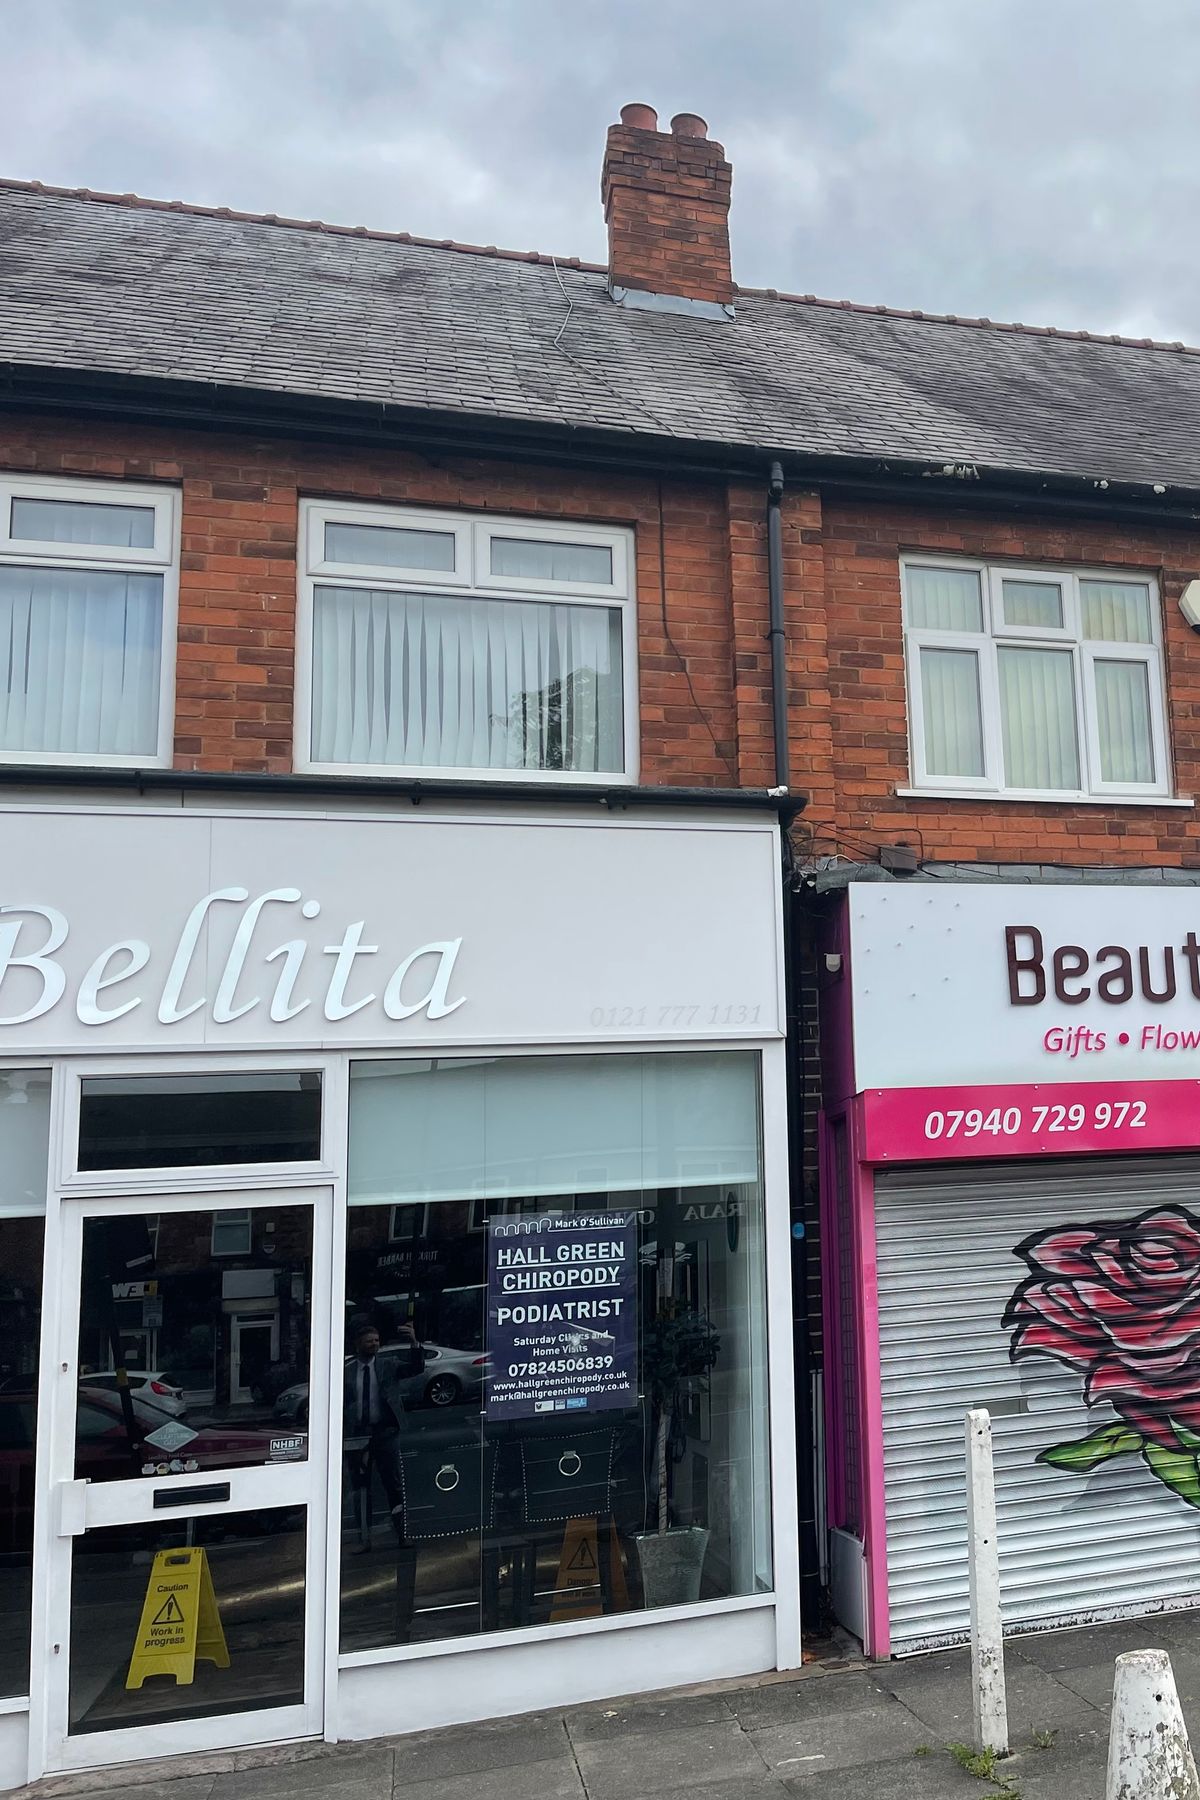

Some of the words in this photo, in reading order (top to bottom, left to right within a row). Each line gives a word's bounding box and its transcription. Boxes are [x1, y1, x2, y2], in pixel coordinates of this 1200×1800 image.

[0, 886, 468, 1026] Bellita
[590, 1005, 648, 1028] 0121
[656, 1004, 701, 1026] 777
[707, 1003, 762, 1025] 1131
[1043, 1024, 1107, 1058] Gifts
[923, 1107, 1022, 1140] 07940
[1031, 1104, 1086, 1134] 729
[1094, 1101, 1147, 1130] 972
[555, 1219, 578, 1229] Mark
[580, 1216, 624, 1227] O'Sullivan
[497, 1246, 551, 1266] HALL
[556, 1241, 625, 1262] GREEN
[502, 1266, 620, 1291] CHIROPODY
[497, 1298, 624, 1326] PODIATRIST
[513, 1333, 557, 1347] Saturday
[533, 1346, 560, 1357] Home
[562, 1343, 588, 1354] Visits
[508, 1355, 613, 1377] 07824506839
[490, 1380, 630, 1402] mark@hallgreenchiropody.co.uk
[493, 1370, 627, 1391] www.hallgreenchiropody.co.uk
[272, 1438, 301, 1450] NHBF
[157, 1583, 189, 1593] Caution
[144, 1636, 186, 1648] progress
[150, 1627, 173, 1637] Work
[175, 1626, 184, 1635] in
